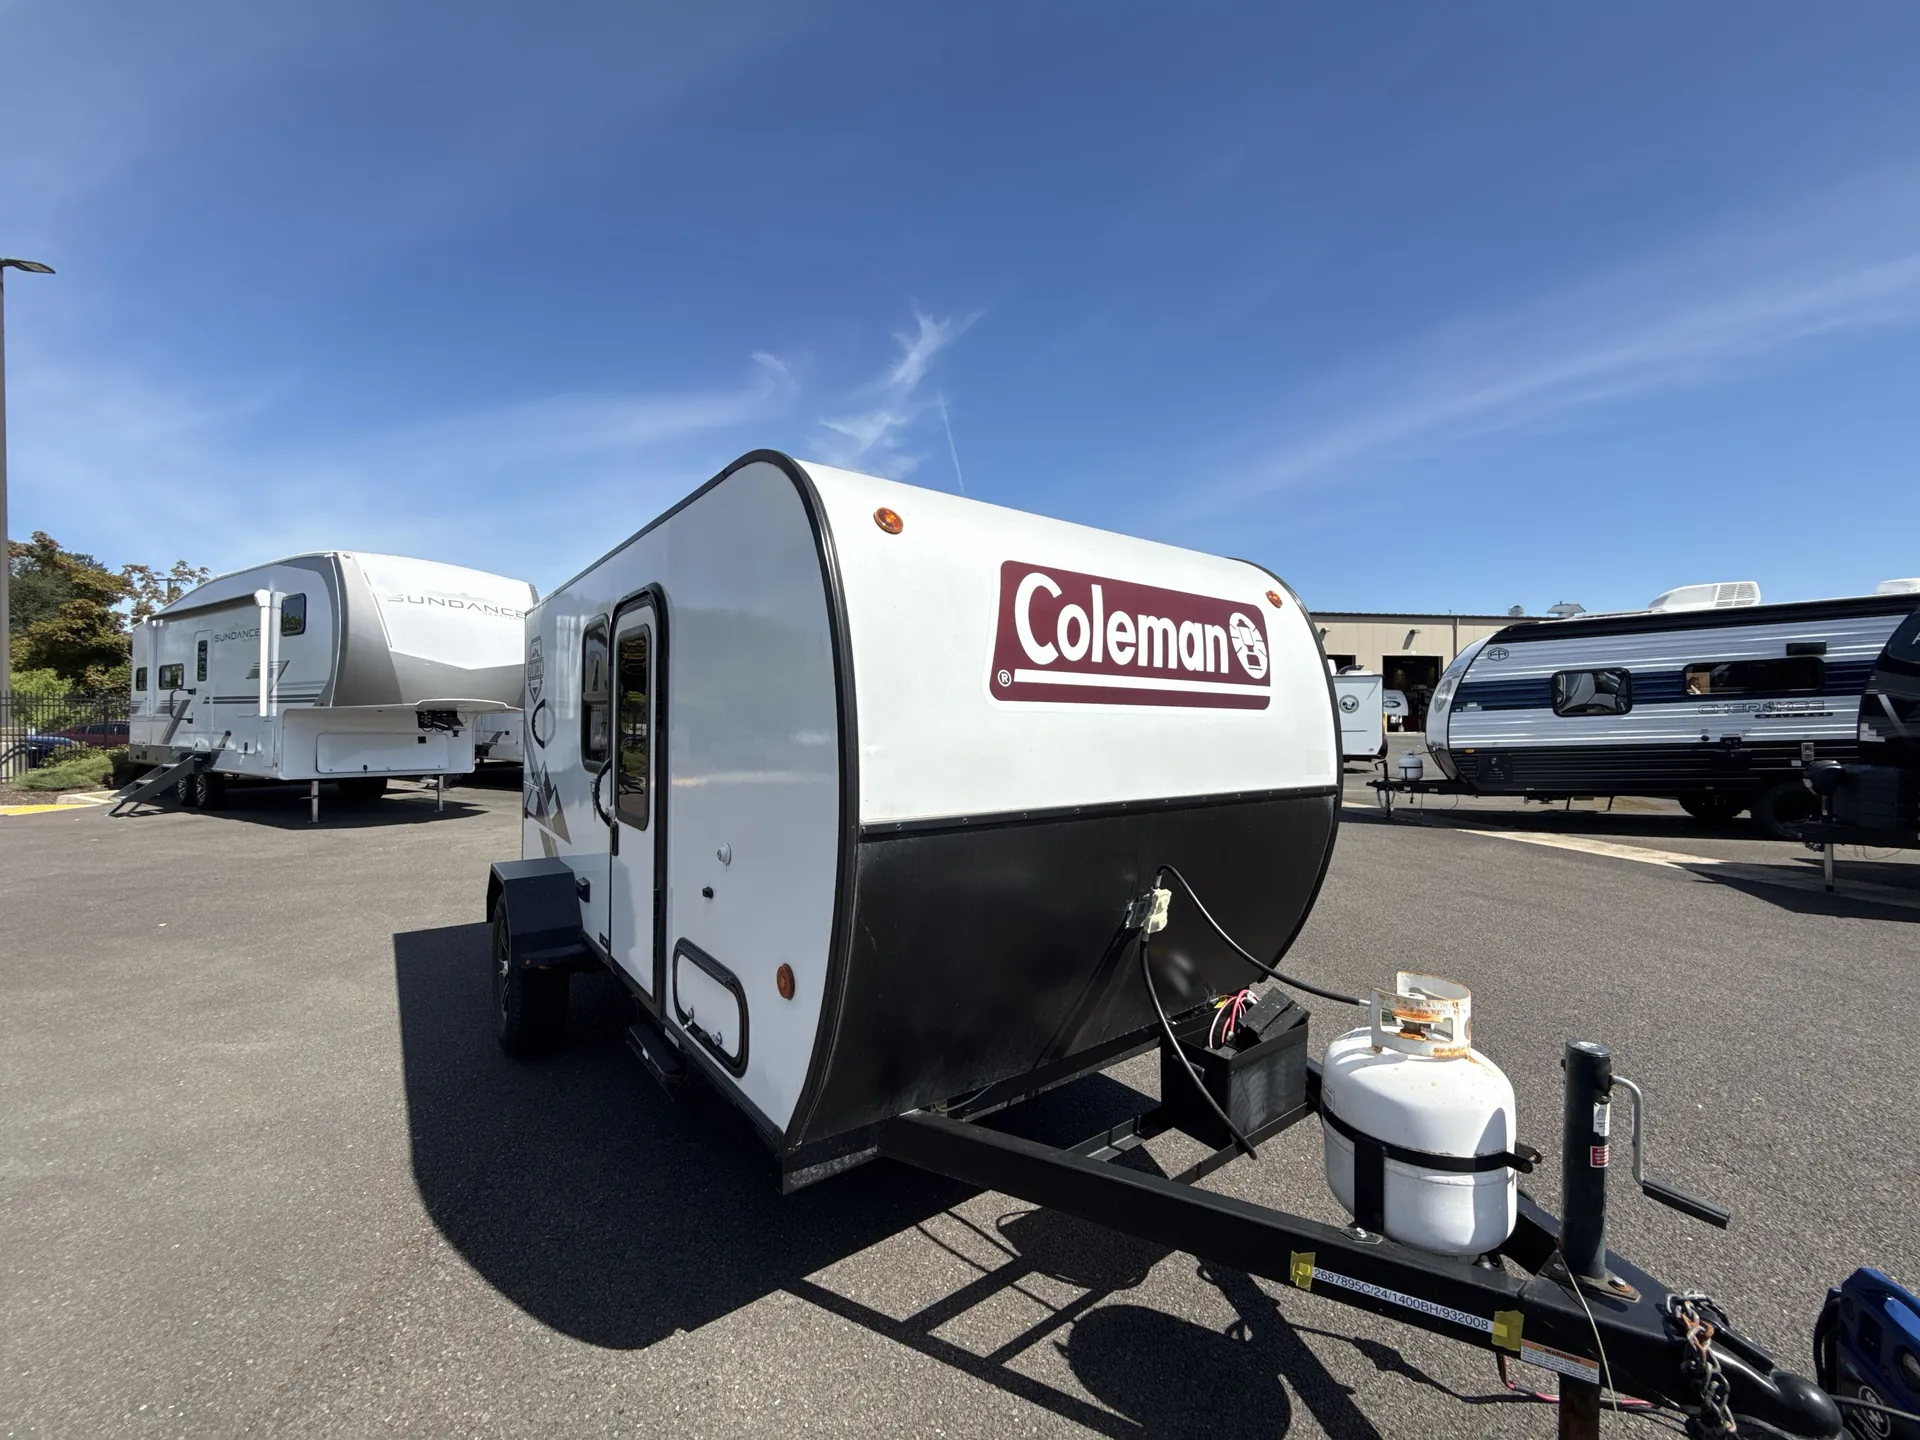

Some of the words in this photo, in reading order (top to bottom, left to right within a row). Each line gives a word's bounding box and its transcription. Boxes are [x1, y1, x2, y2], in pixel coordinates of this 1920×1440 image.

[386, 594, 526, 619] SUNDANCE
[1014, 572, 1230, 674] Coleman
[214, 627, 260, 643] SUNDANCE
[1697, 700, 1825, 715] CHEROKEE
[1313, 1268, 1489, 1330] 2687895C/24/1400BH/932008
[1543, 1347, 1581, 1363] WARNING
